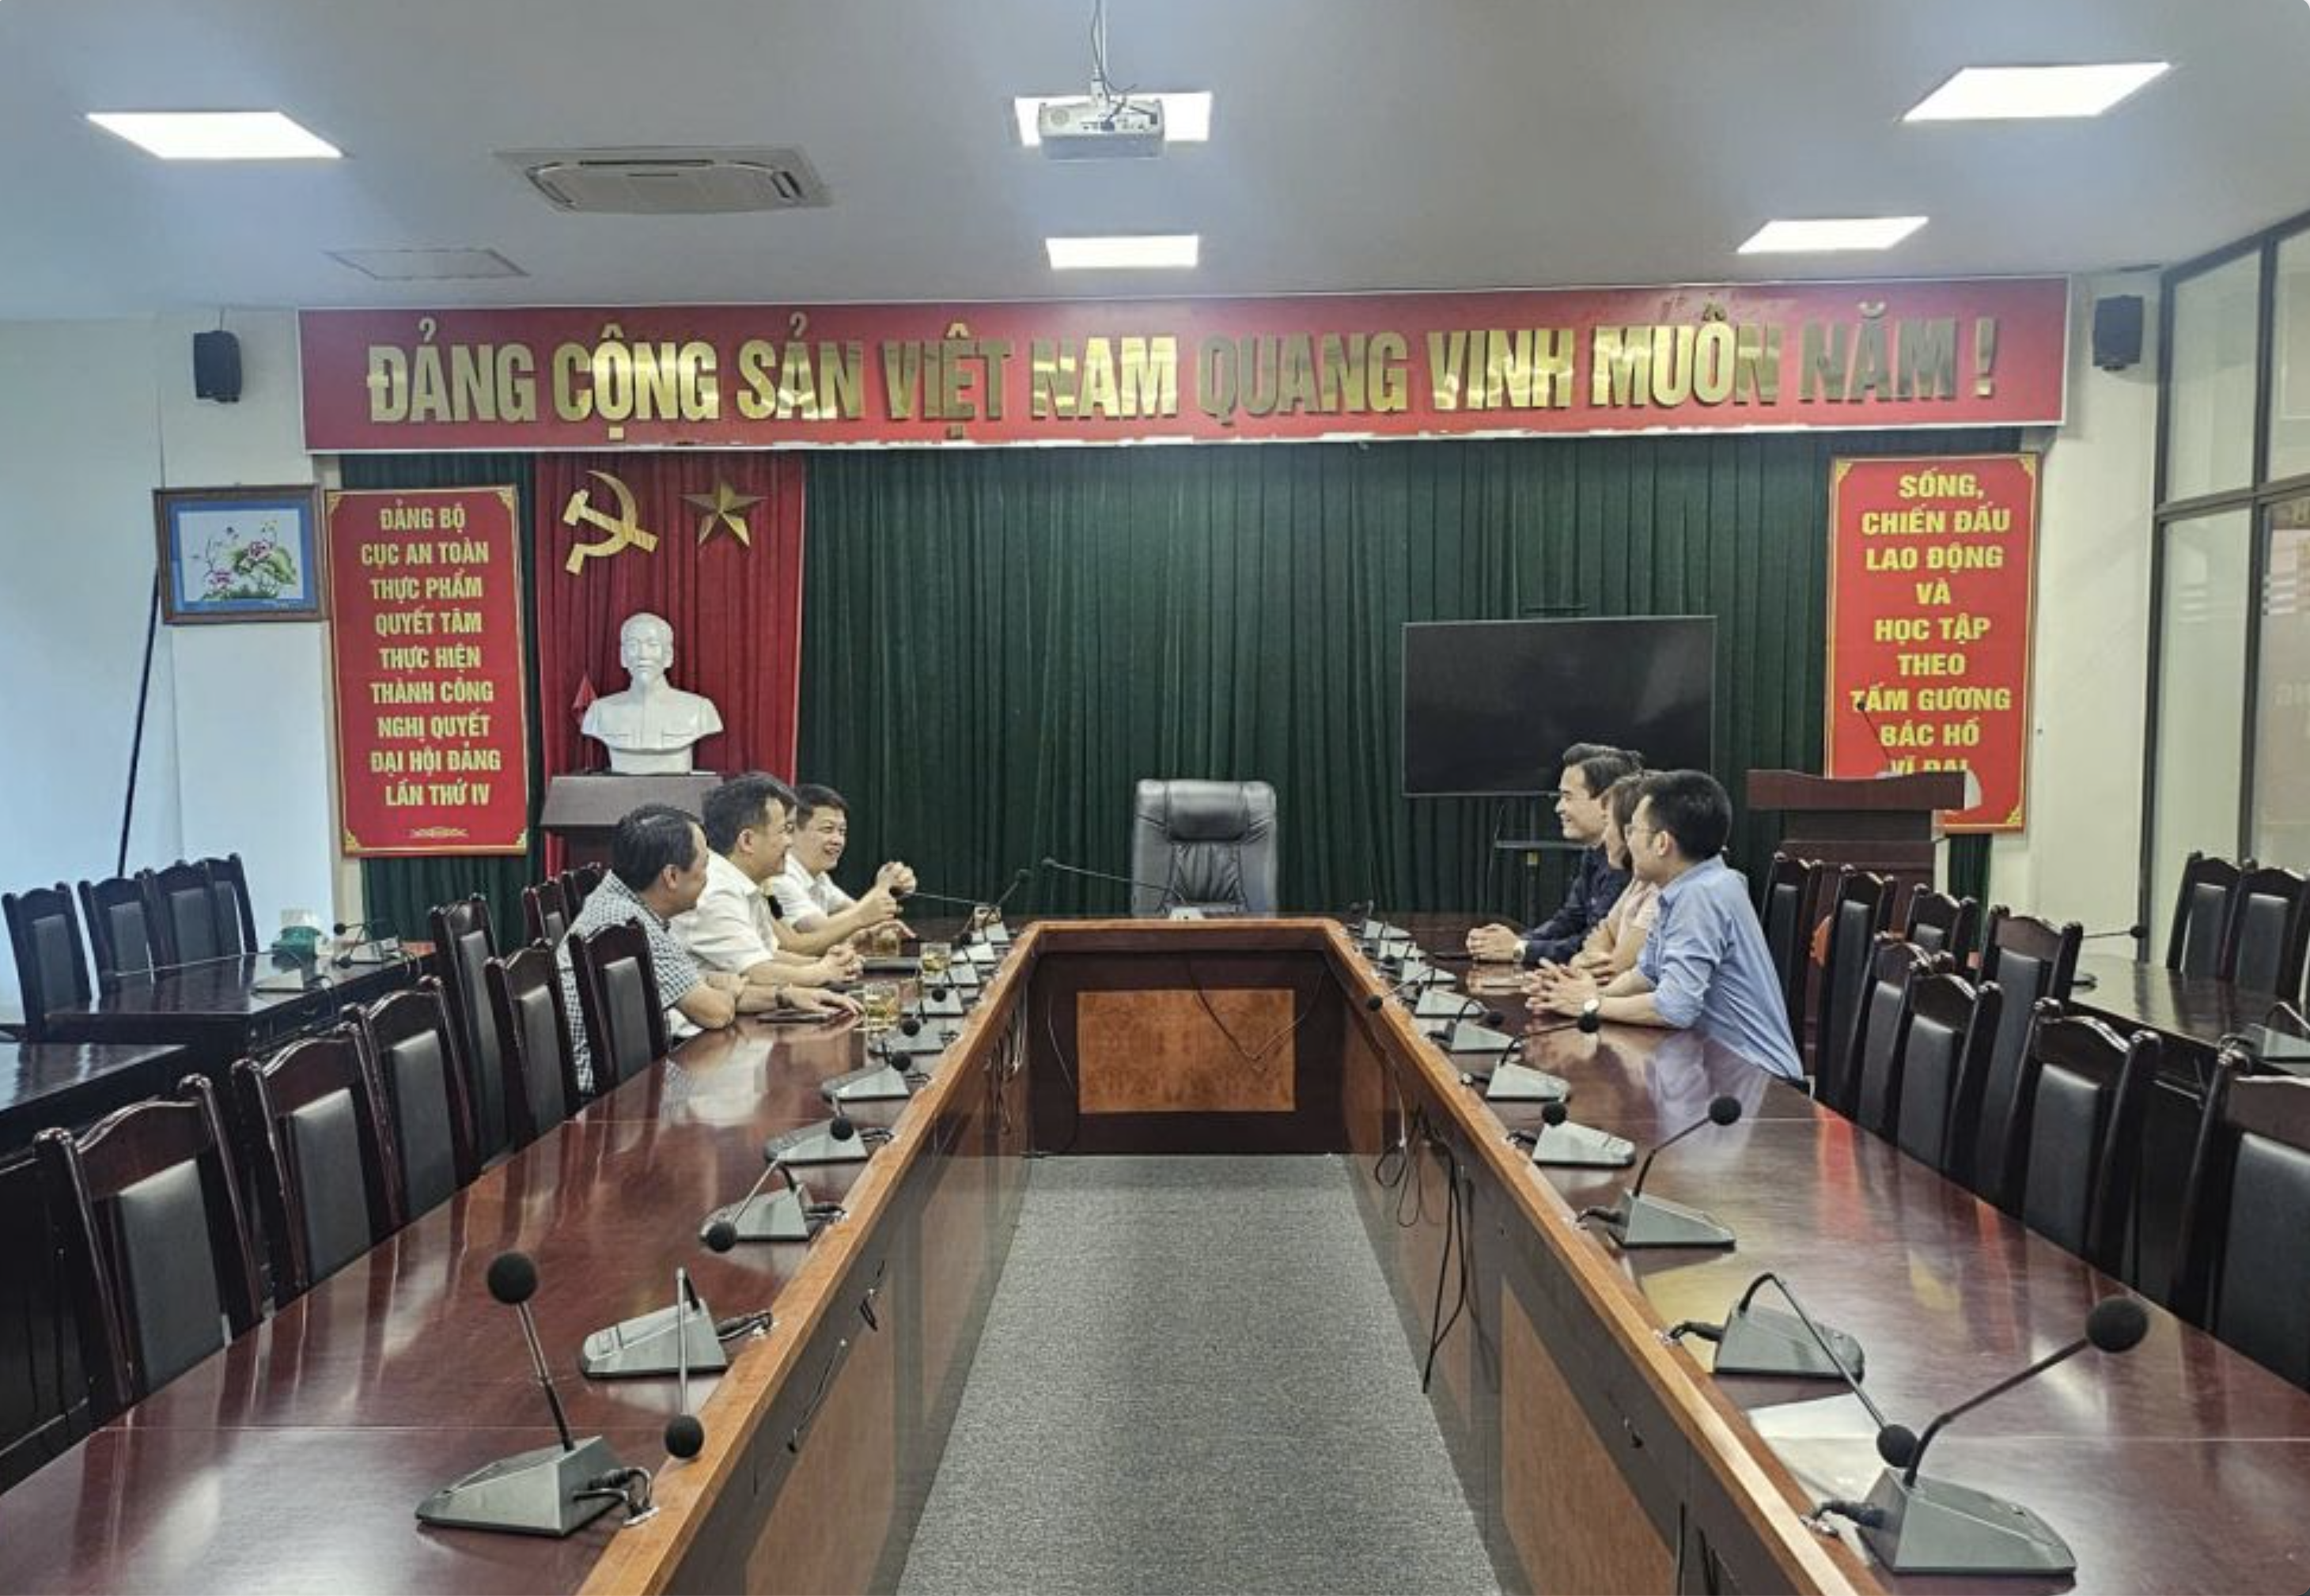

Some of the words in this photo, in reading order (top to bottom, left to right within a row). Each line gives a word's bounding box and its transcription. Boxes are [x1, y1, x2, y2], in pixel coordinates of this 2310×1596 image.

[366, 318, 537, 422] ĐẢNG
[553, 323, 719, 441] CỘNG
[737, 312, 863, 420] SẢN
[883, 322, 1013, 439] VIỆT
[1032, 336, 1178, 420] NAM
[1199, 331, 1408, 426] QUANG
[1427, 328, 1575, 410] VINH
[1799, 301, 1958, 402] NĂM
[1975, 318, 1998, 397] !
[1898, 467, 1985, 499] SỐNG,
[379, 498, 434, 531] ĐẢNG
[440, 501, 466, 534] BỘ
[1861, 503, 1946, 535] CHIẾN
[1954, 501, 2010, 534] ĐẤU
[361, 543, 400, 570] CỤC
[405, 543, 433, 565] AN
[437, 537, 490, 565] TOÀN
[1865, 546, 1918, 571] LAO
[1926, 542, 2004, 573] ĐỘNG
[370, 576, 420, 603] THỰC
[426, 568, 483, 599] PHẨM
[1915, 577, 1952, 605] VÀ
[375, 605, 434, 637] QUYẾT
[440, 607, 483, 633] TÂM
[1873, 618, 1930, 646] HỌC
[1938, 612, 1992, 645] TẬP
[378, 643, 430, 673] THỰC
[435, 642, 482, 673] HIỆN
[1896, 652, 1967, 676] THEO
[369, 677, 435, 704] THÀNH
[440, 676, 494, 704] CÔNG
[1850, 682, 1910, 712] TẤM
[1917, 686, 2013, 712] GƯƠNG
[377, 717, 426, 743] NGHỊ
[430, 707, 491, 740] QUYẾT
[1880, 719, 1935, 747] BÁC
[370, 751, 403, 777] ĐẠI
[409, 745, 442, 777] HỘI
[447, 741, 502, 772] ĐẢNG
[428, 777, 468, 806] THỨ
[471, 783, 491, 806] IV
